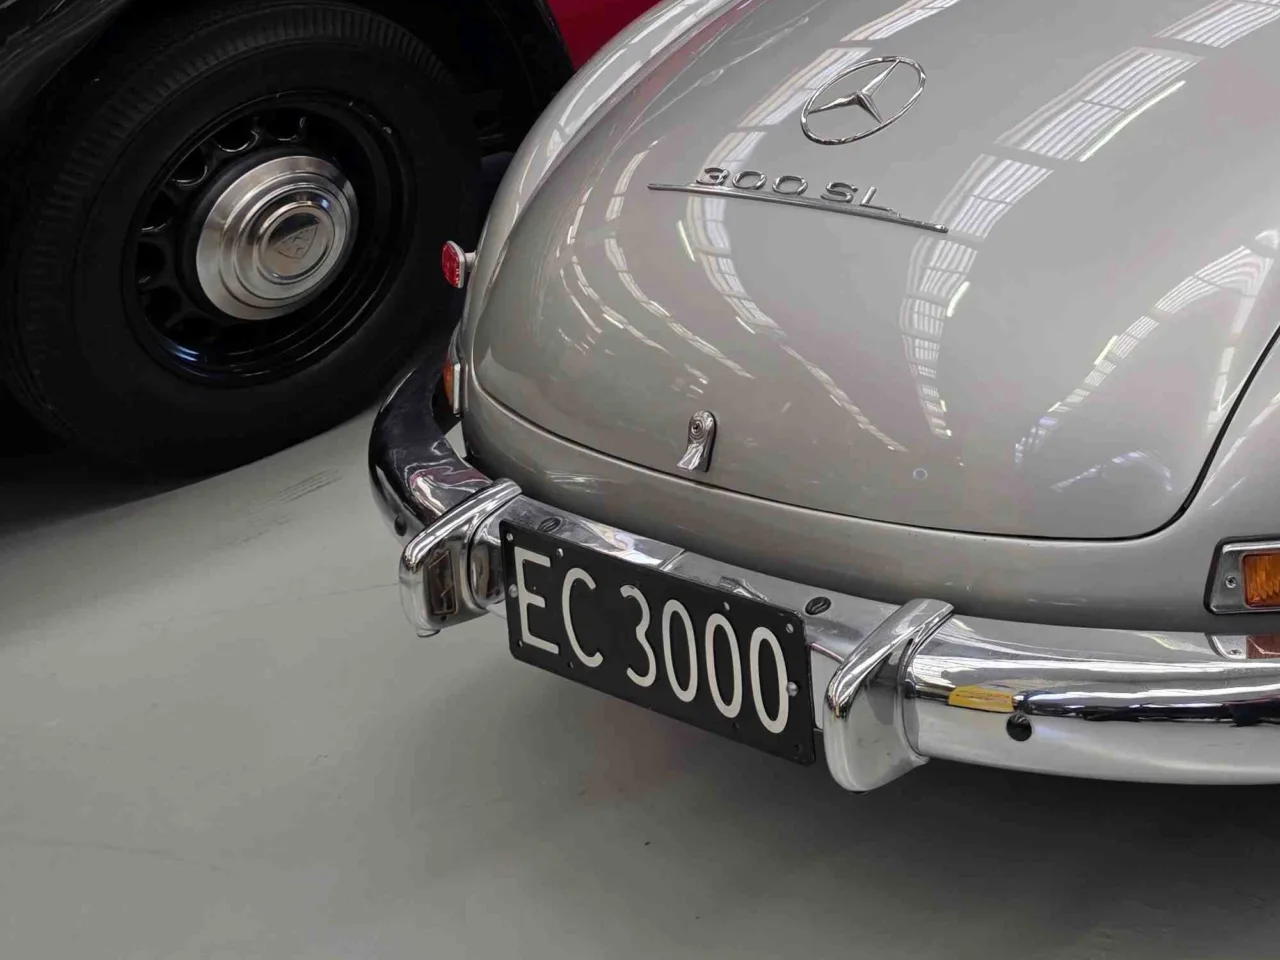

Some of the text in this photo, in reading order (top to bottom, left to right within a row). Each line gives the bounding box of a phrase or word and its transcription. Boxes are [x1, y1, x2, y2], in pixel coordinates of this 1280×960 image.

[696, 167, 894, 212] 300 SL
[514, 545, 790, 734] EC 3000
